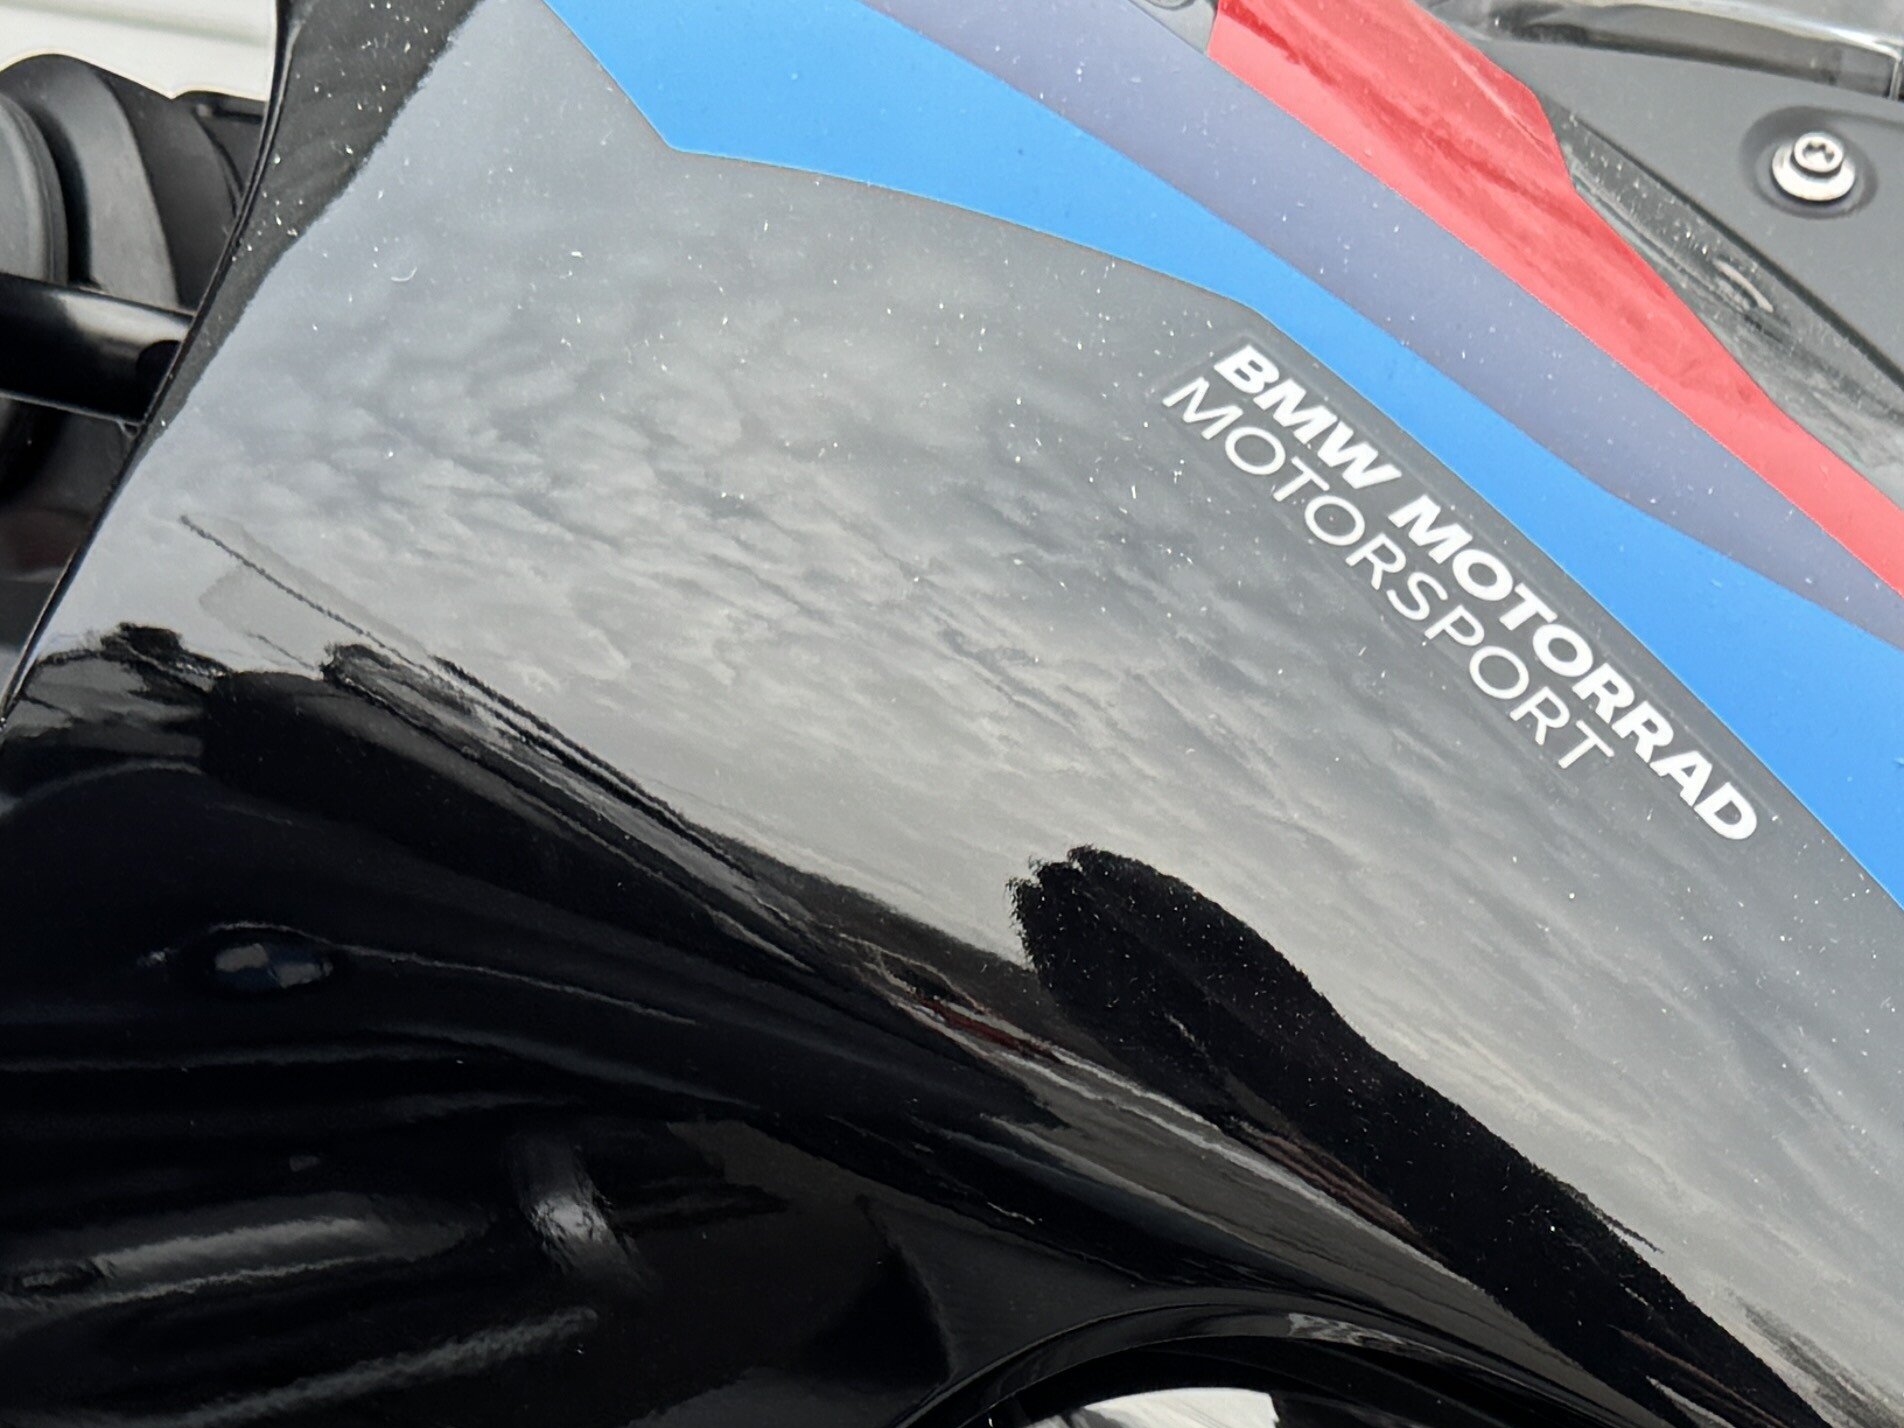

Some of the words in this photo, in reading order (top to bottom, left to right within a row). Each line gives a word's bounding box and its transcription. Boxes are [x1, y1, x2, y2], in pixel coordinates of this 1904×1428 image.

[1162, 376, 1615, 770] MOTORSPORT
[1213, 345, 1402, 490] BMW
[1388, 494, 1757, 841] MOTORRAD
